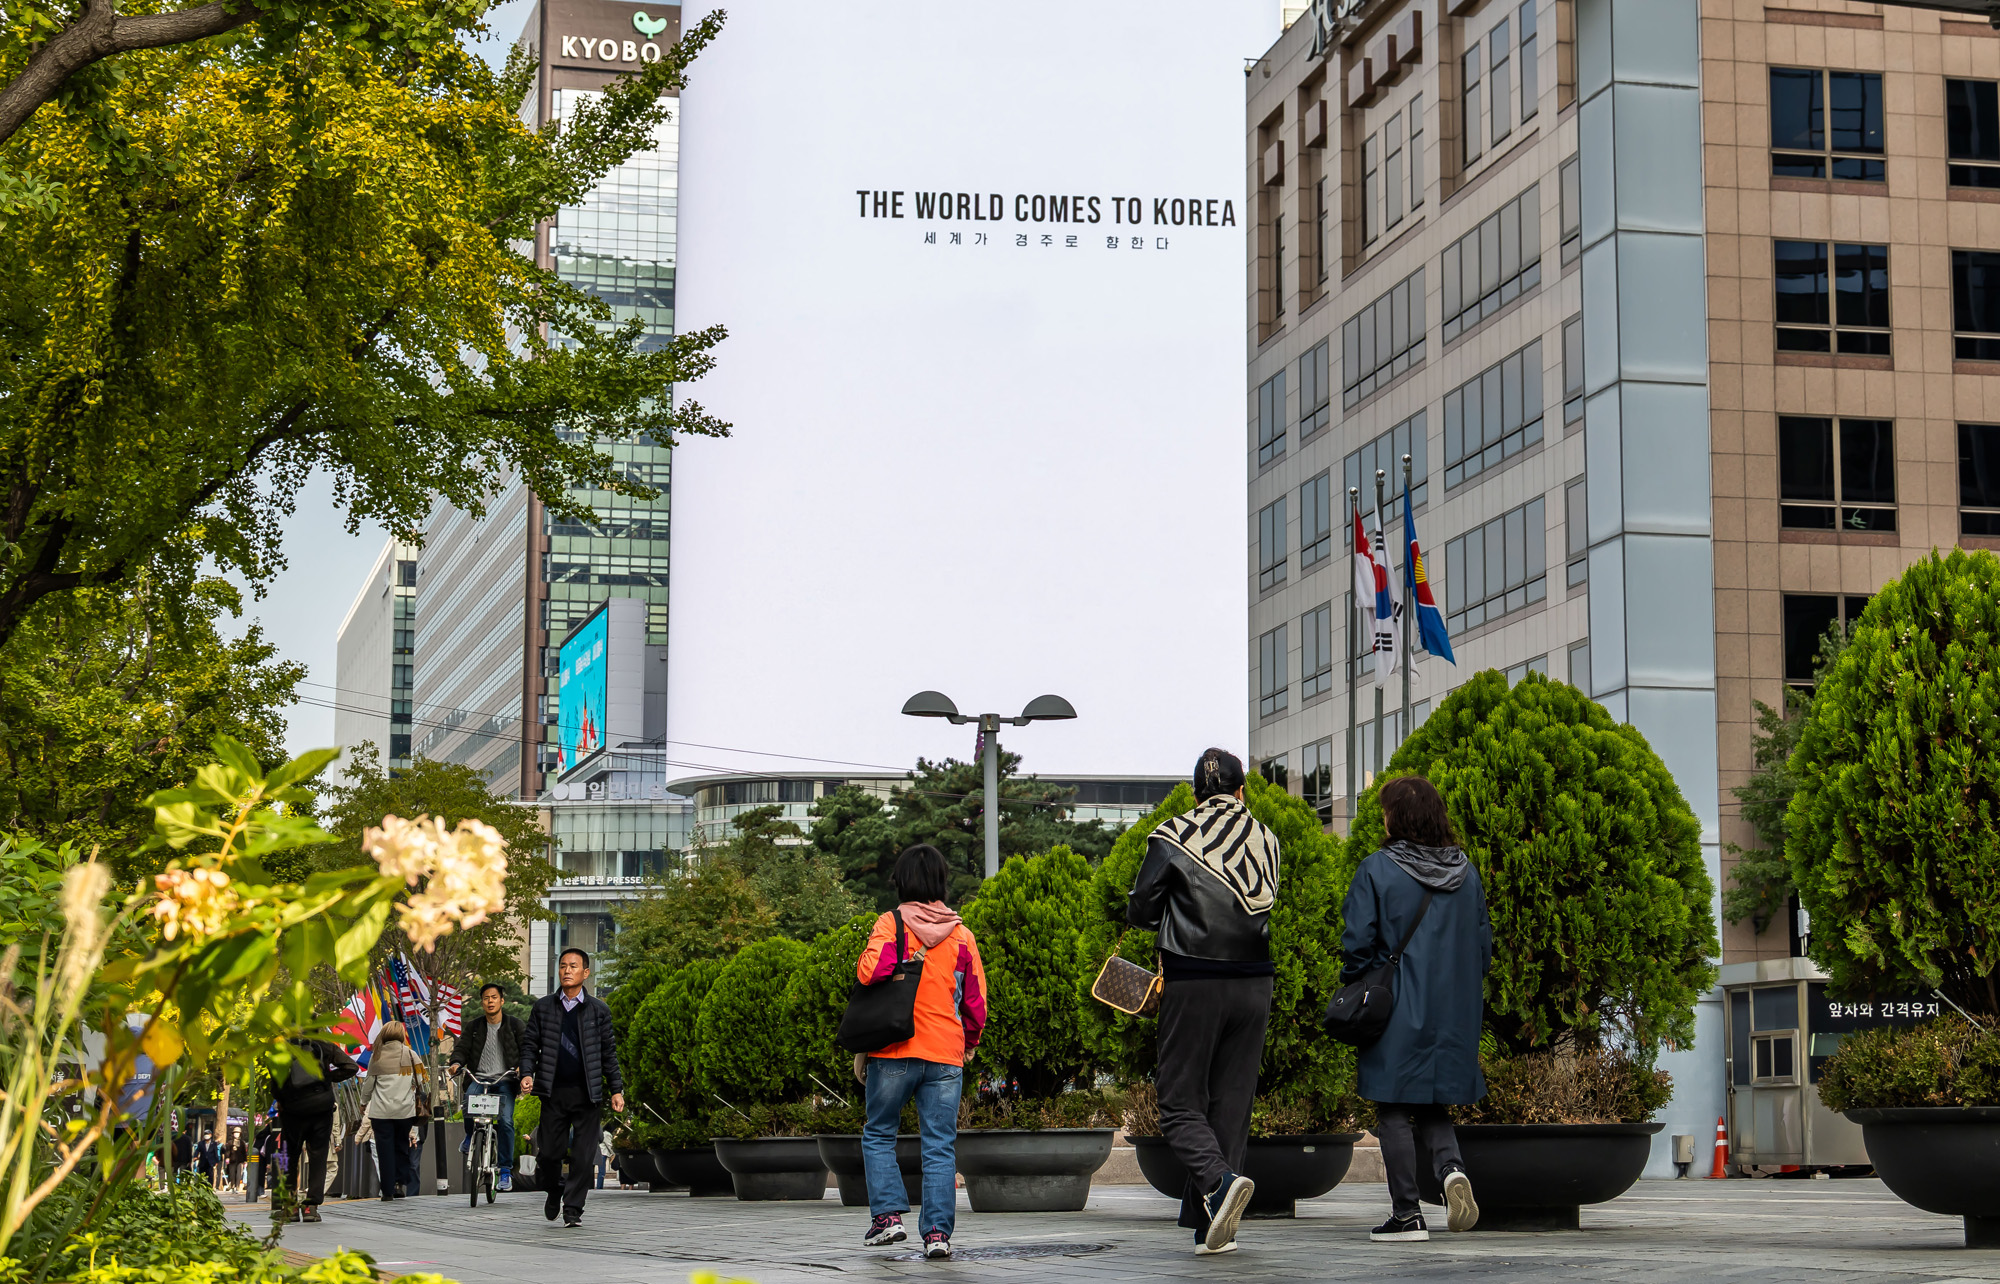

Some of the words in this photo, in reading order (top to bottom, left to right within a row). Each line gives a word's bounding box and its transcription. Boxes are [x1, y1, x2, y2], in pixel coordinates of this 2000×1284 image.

[561, 35, 661, 64] KYOBO
[856, 190, 905, 219] THE
[915, 191, 1004, 221] WORLD
[1014, 193, 1102, 223] COMES
[1111, 196, 1142, 224] TO
[1153, 197, 1237, 227] KOREA
[924, 231, 988, 246] 세계가
[1015, 233, 1079, 248] 경주로
[1106, 235, 1170, 251] 향한다
[1829, 1001, 1874, 1018] 앞차와
[1880, 1001, 1940, 1018] 간격유지
